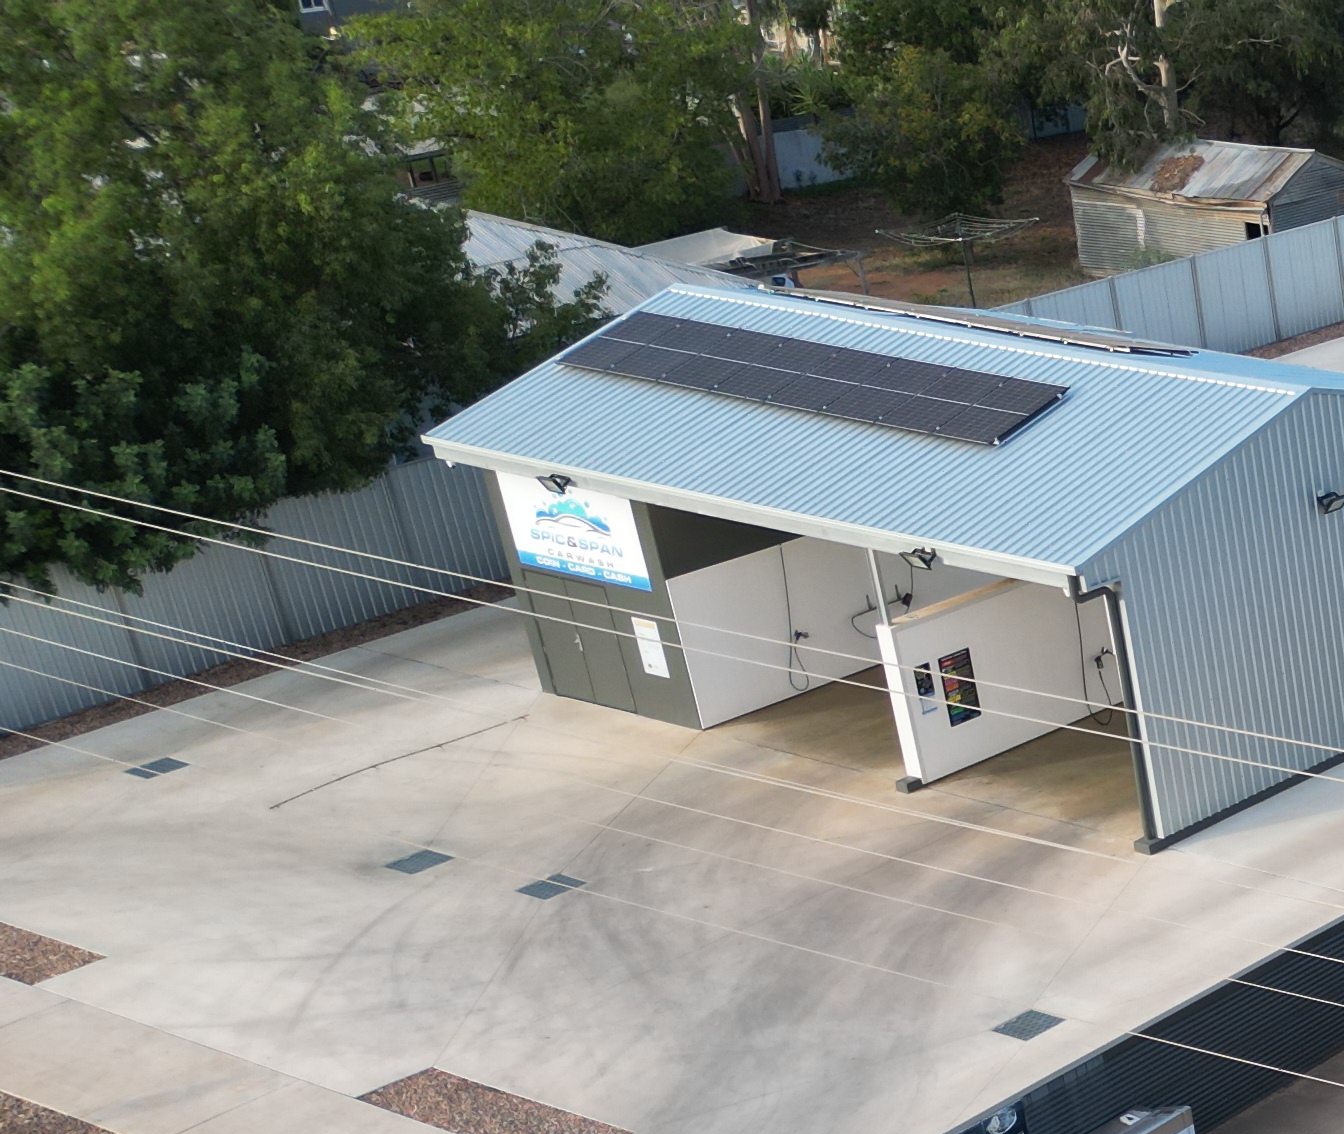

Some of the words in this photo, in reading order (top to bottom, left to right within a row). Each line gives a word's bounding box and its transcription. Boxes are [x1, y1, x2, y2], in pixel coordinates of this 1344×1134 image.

[536, 556, 560, 569] COIN
[567, 563, 596, 576] CARD
[603, 569, 632, 584] CASH
[547, 548, 614, 569] CARWASH
